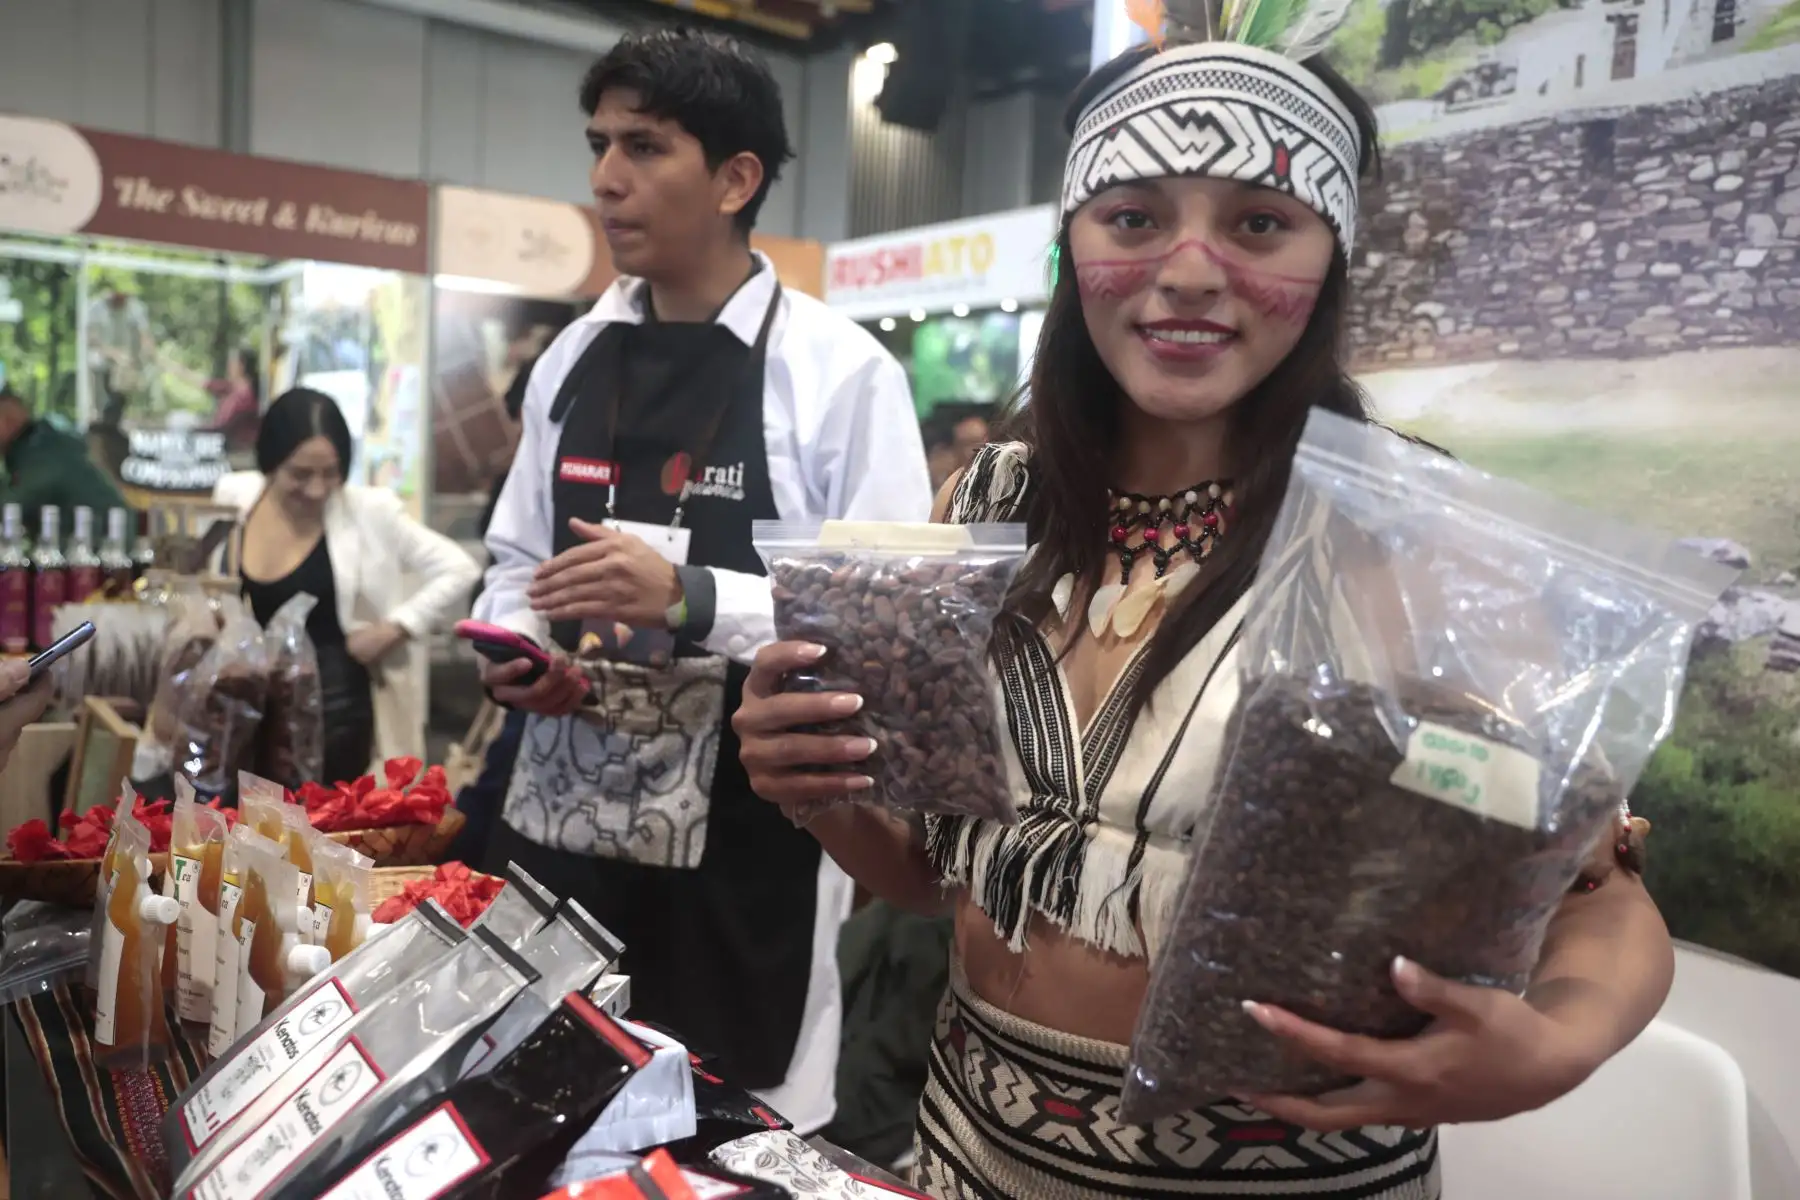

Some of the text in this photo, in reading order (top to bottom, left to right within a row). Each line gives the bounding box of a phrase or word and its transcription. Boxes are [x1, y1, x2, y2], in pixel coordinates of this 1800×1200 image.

[113, 176, 175, 213] The
[179, 184, 269, 226] Sweet
[272, 201, 297, 230] &
[274, 1017, 299, 1059] Kenatos
